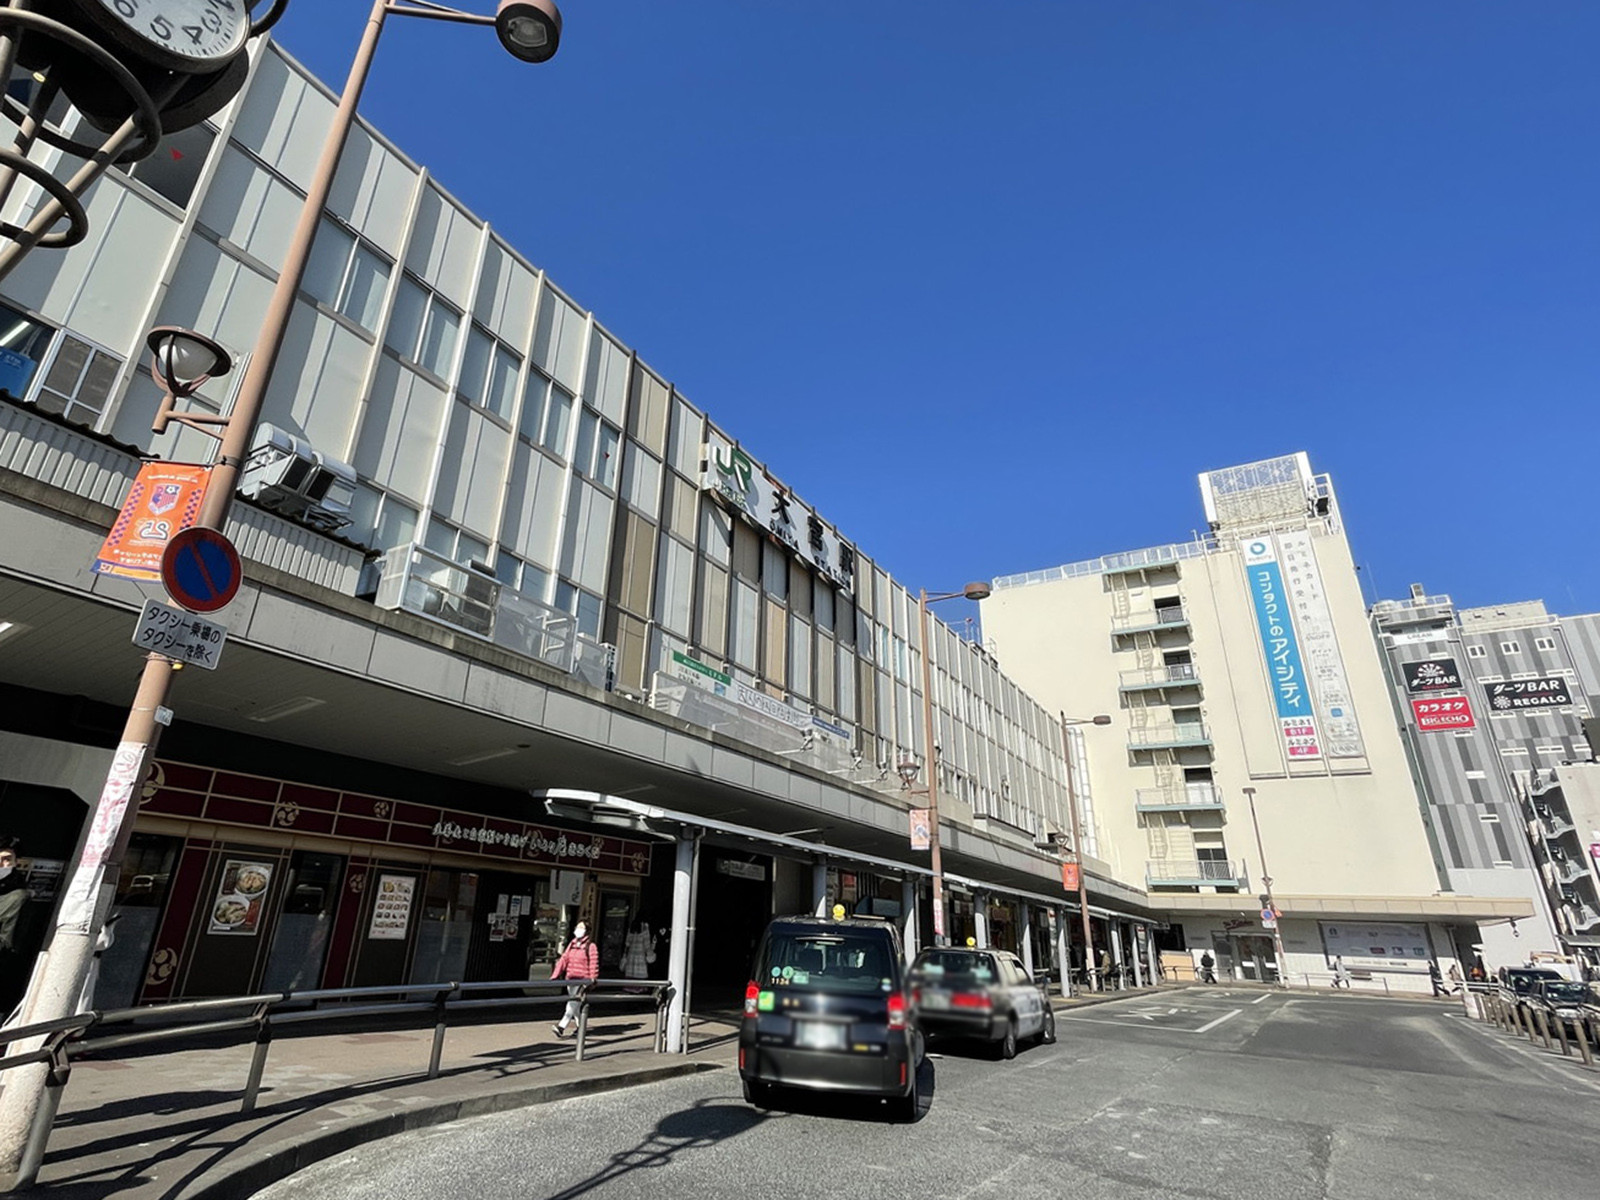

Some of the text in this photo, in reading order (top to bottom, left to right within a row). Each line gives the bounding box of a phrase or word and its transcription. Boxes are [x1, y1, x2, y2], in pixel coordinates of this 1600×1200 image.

[150, 14, 174, 41] 5
[181, 25, 203, 46] 4
[712, 446, 753, 494] JR
[148, 606, 221, 644] タクシー乗場の
[143, 627, 213, 663] タクシーを除く
[1257, 571, 1302, 708] コンタクトのアイシティ
[1411, 675, 1458, 687] ダーツBAR
[1493, 680, 1560, 695] ダーツBAR
[1418, 702, 1465, 713] カラオケ
